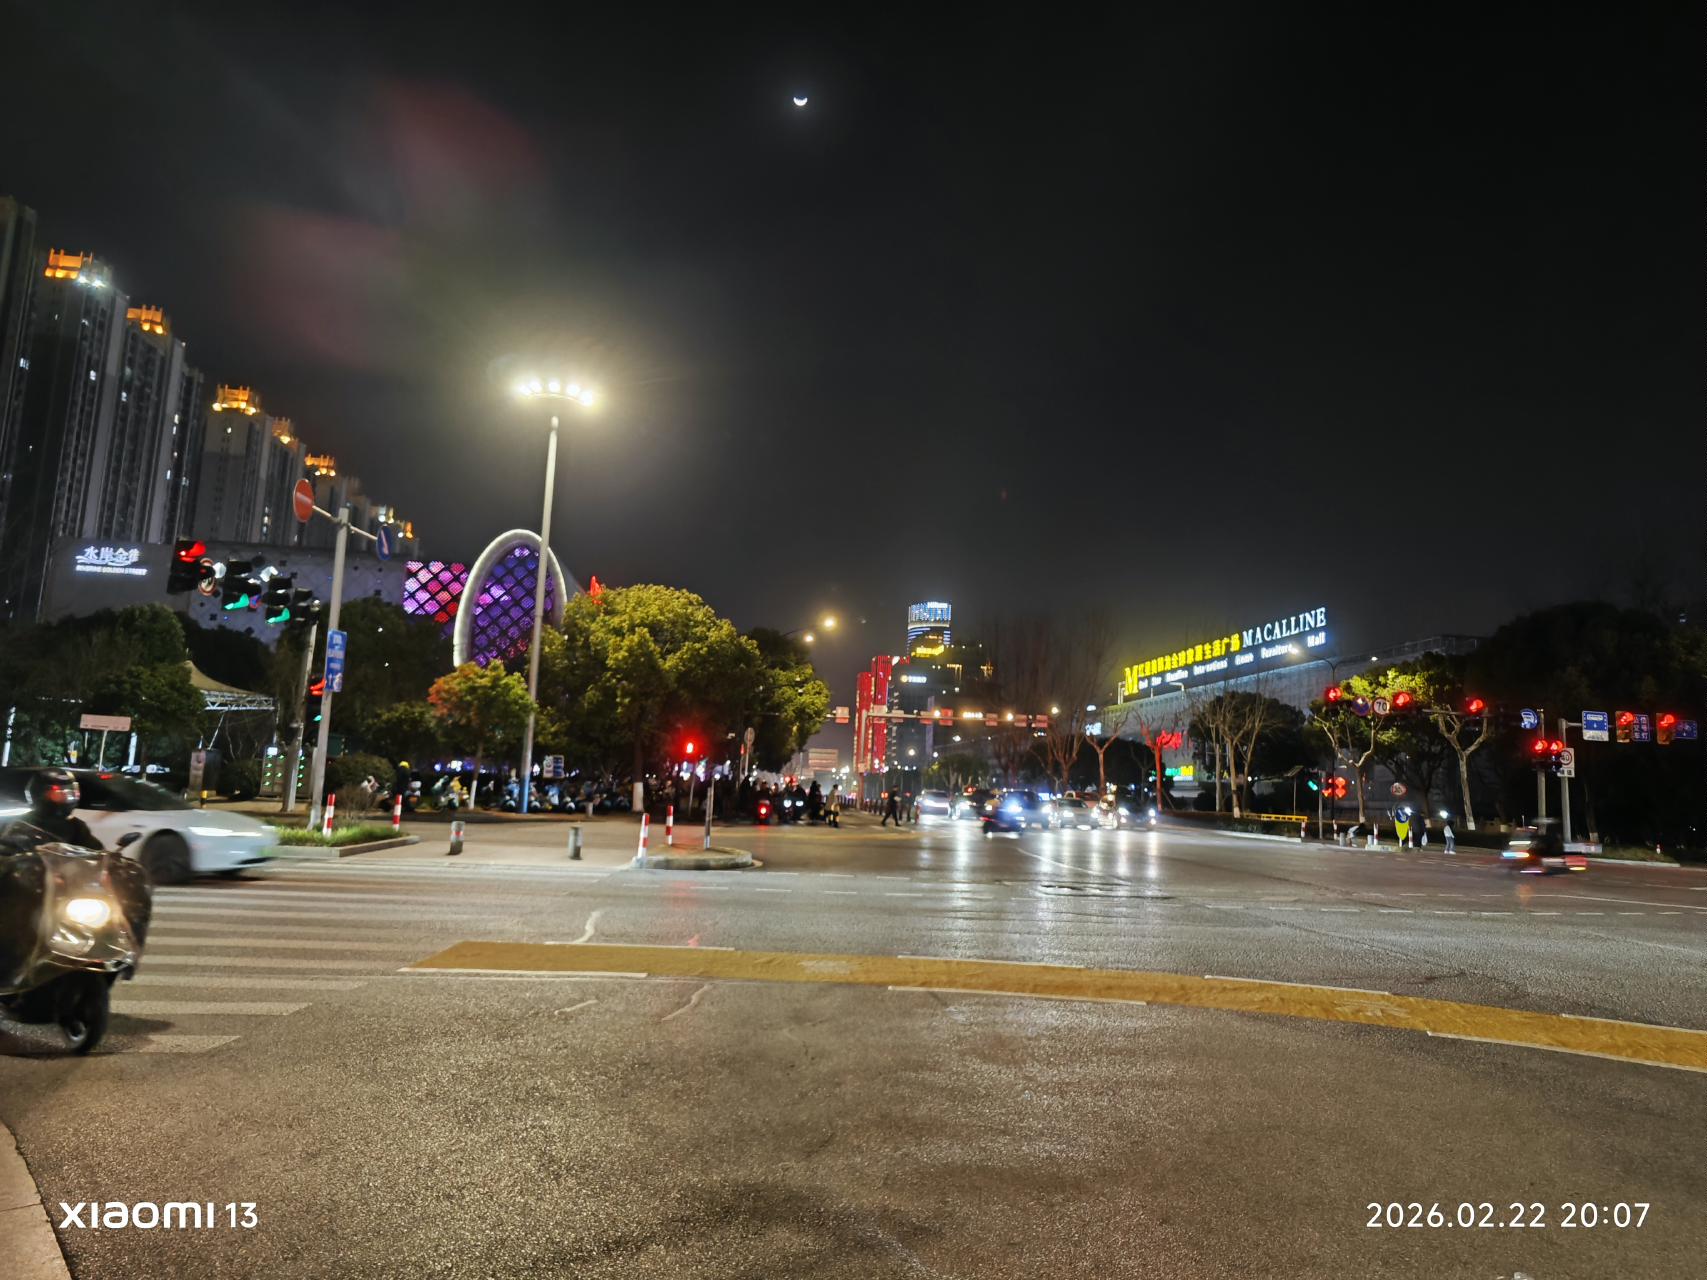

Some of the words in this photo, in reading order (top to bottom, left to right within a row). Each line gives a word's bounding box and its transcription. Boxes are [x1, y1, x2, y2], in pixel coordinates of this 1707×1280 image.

[1242, 606, 1327, 648] MACALLINE
[1307, 631, 1326, 648] Mall
[1376, 701, 1387, 712] 70
